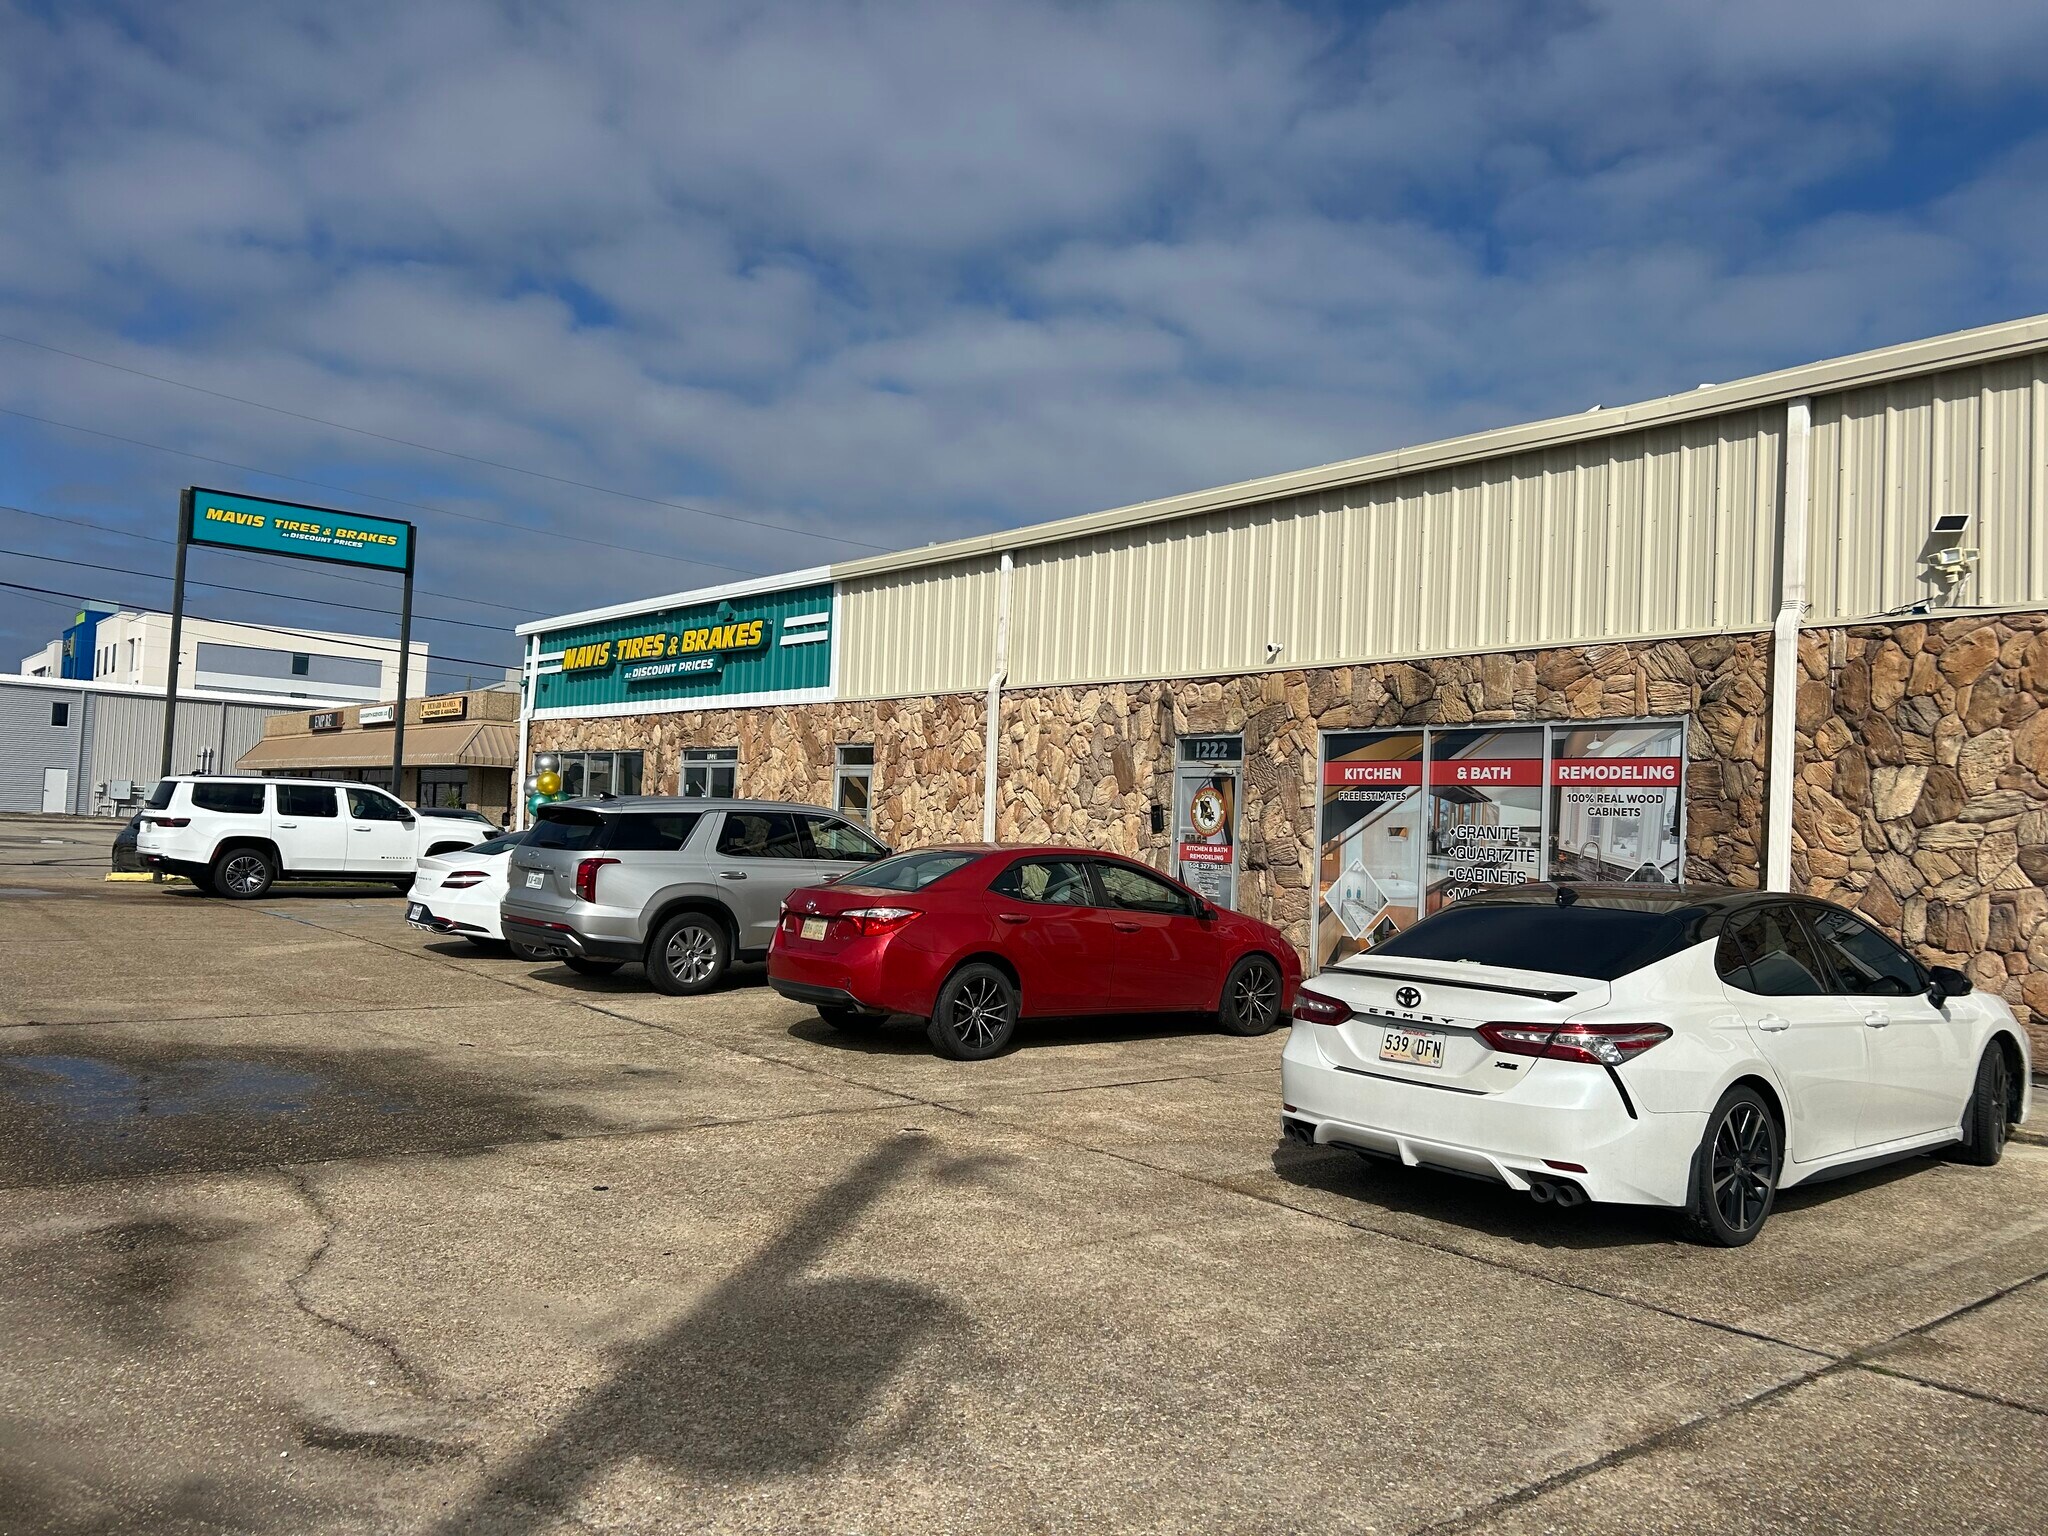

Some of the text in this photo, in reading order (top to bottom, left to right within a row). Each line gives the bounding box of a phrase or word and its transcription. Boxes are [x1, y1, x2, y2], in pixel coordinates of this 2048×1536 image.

[206, 508, 398, 545] MAVIS TIRES & BRAKES
[290, 532, 332, 544] DISCOUNT
[333, 539, 363, 548] PRICES
[563, 620, 764, 671] MAVIS TIRES & BRAKES
[632, 663, 677, 678] DISCOUNT
[678, 658, 714, 672] PRICES
[1196, 741, 1228, 758] 1222
[1344, 765, 1675, 780] KITCHEN & BATH REMODELING
[1339, 791, 1407, 801] FREE ESTIMATES
[1566, 793, 1664, 804] 100% REAL WOOD
[1587, 807, 1641, 817] CABINETS
[1456, 825, 1519, 840] GRANITE
[1190, 853, 1224, 861] REMODELING
[1456, 846, 1535, 863] QUARTZITE
[1455, 867, 1527, 884] CABINETS
[1369, 1007, 1455, 1024] CAMRY
[1384, 1034, 1442, 1059] 539 DFN
